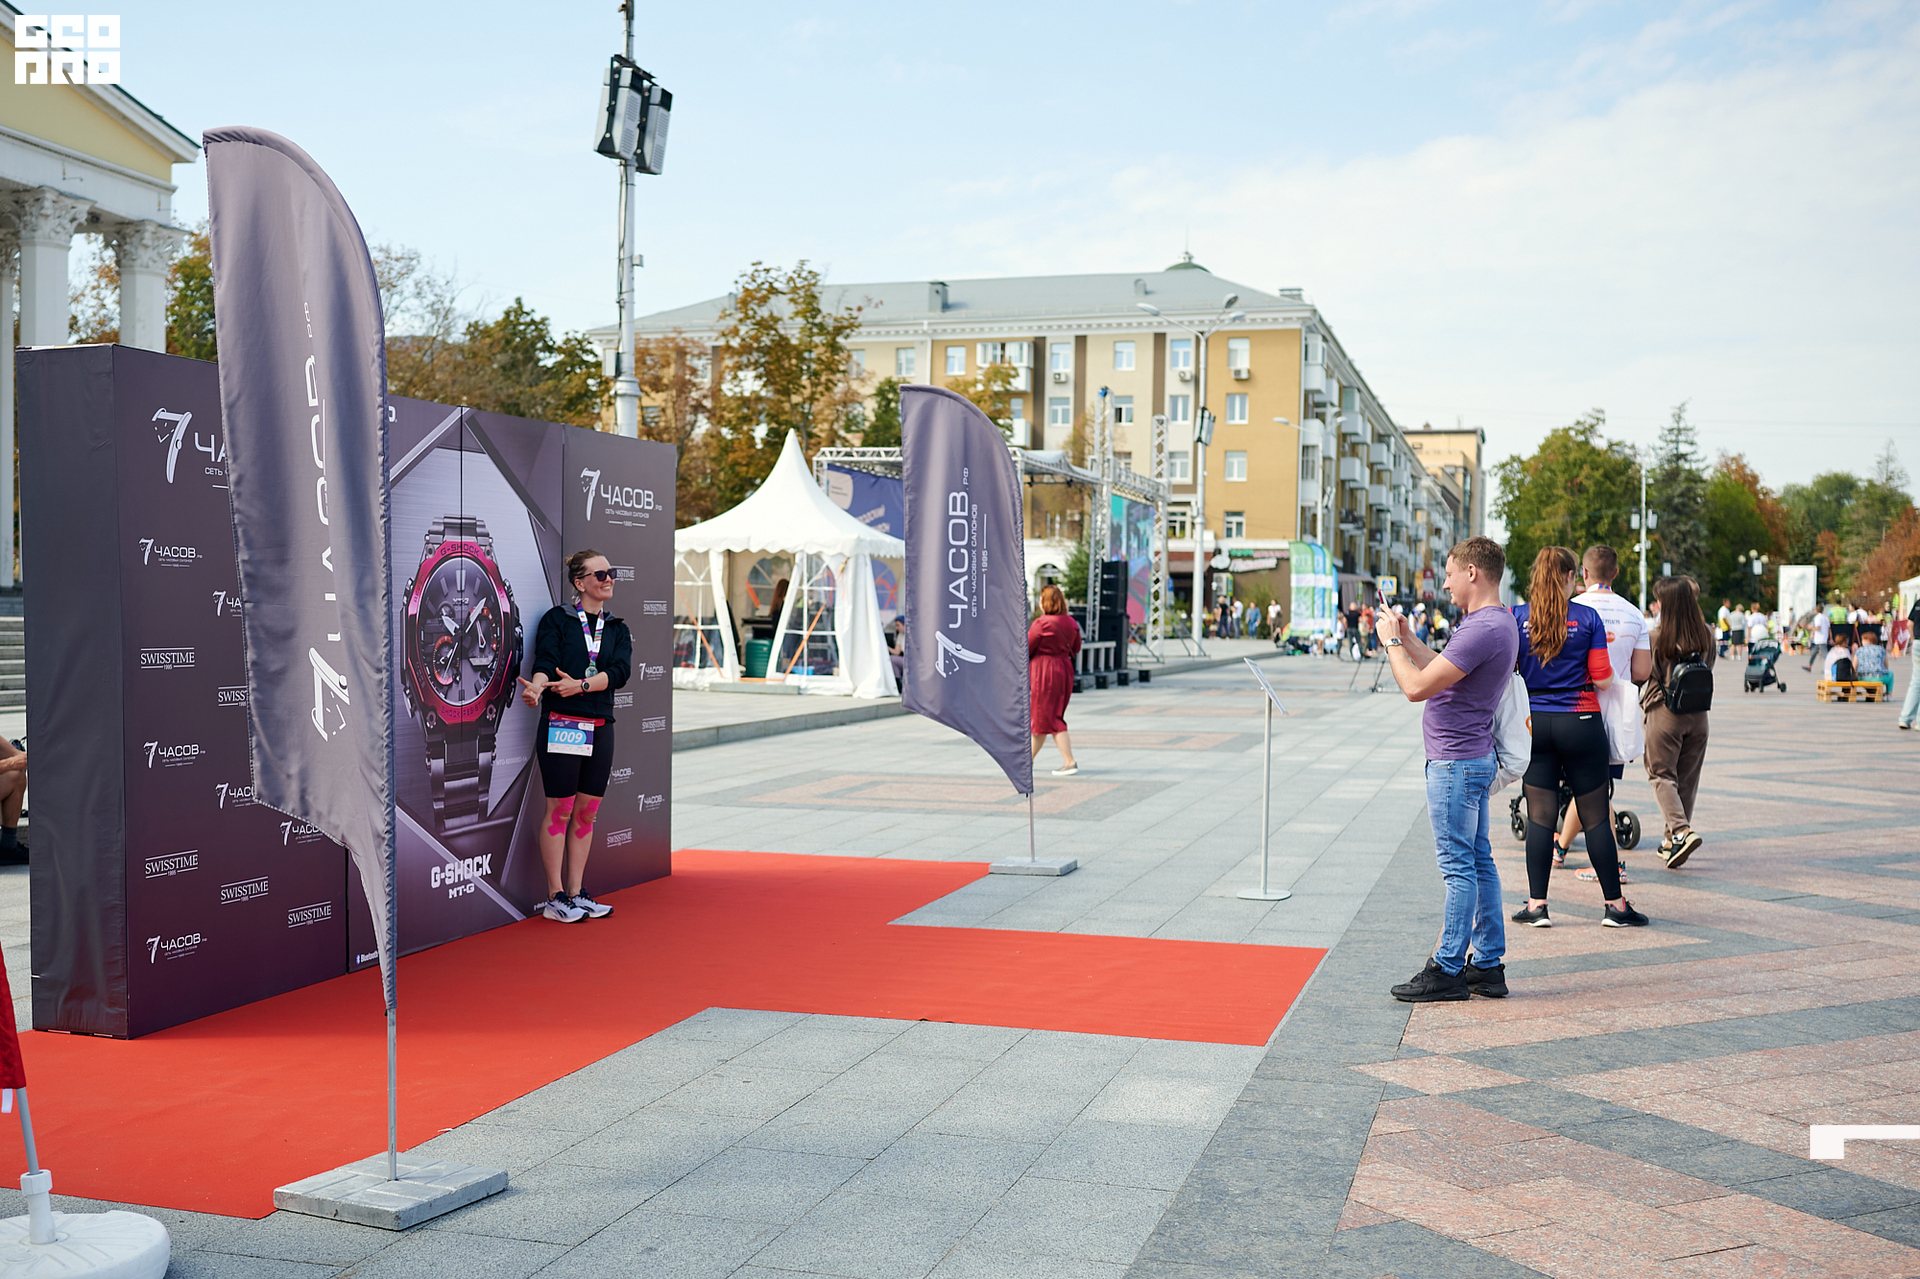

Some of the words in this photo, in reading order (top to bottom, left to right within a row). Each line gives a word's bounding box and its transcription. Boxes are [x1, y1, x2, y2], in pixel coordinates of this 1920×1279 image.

[151, 407, 193, 484] 7
[205, 467, 223, 476] СЕТЬ
[580, 467, 601, 521] 7
[600, 483, 654, 510] ЧАСОВ
[139, 537, 155, 566] 7
[154, 545, 196, 558] ЧАСОВ
[440, 543, 480, 557] G-SHOCK
[948, 491, 969, 629] ЧАСОВ
[981, 549, 989, 573] 1995
[212, 590, 226, 617] 7
[140, 652, 195, 665] SWISSTIME
[935, 630, 987, 679] 7
[638, 662, 646, 681] 7
[554, 730, 584, 744] 1009
[143, 740, 158, 769] 7
[158, 744, 199, 758] ЧАСОВ
[215, 782, 229, 809] 7
[637, 793, 645, 812] 7
[280, 820, 293, 846] 7
[145, 854, 199, 875] SWISSTIME
[430, 853, 492, 889] G-SHOCK
[220, 880, 269, 901] SWISSTIME
[287, 905, 332, 925] SWISSTIME
[146, 935, 161, 964] 7
[160, 933, 201, 951] ЧАСОВ
